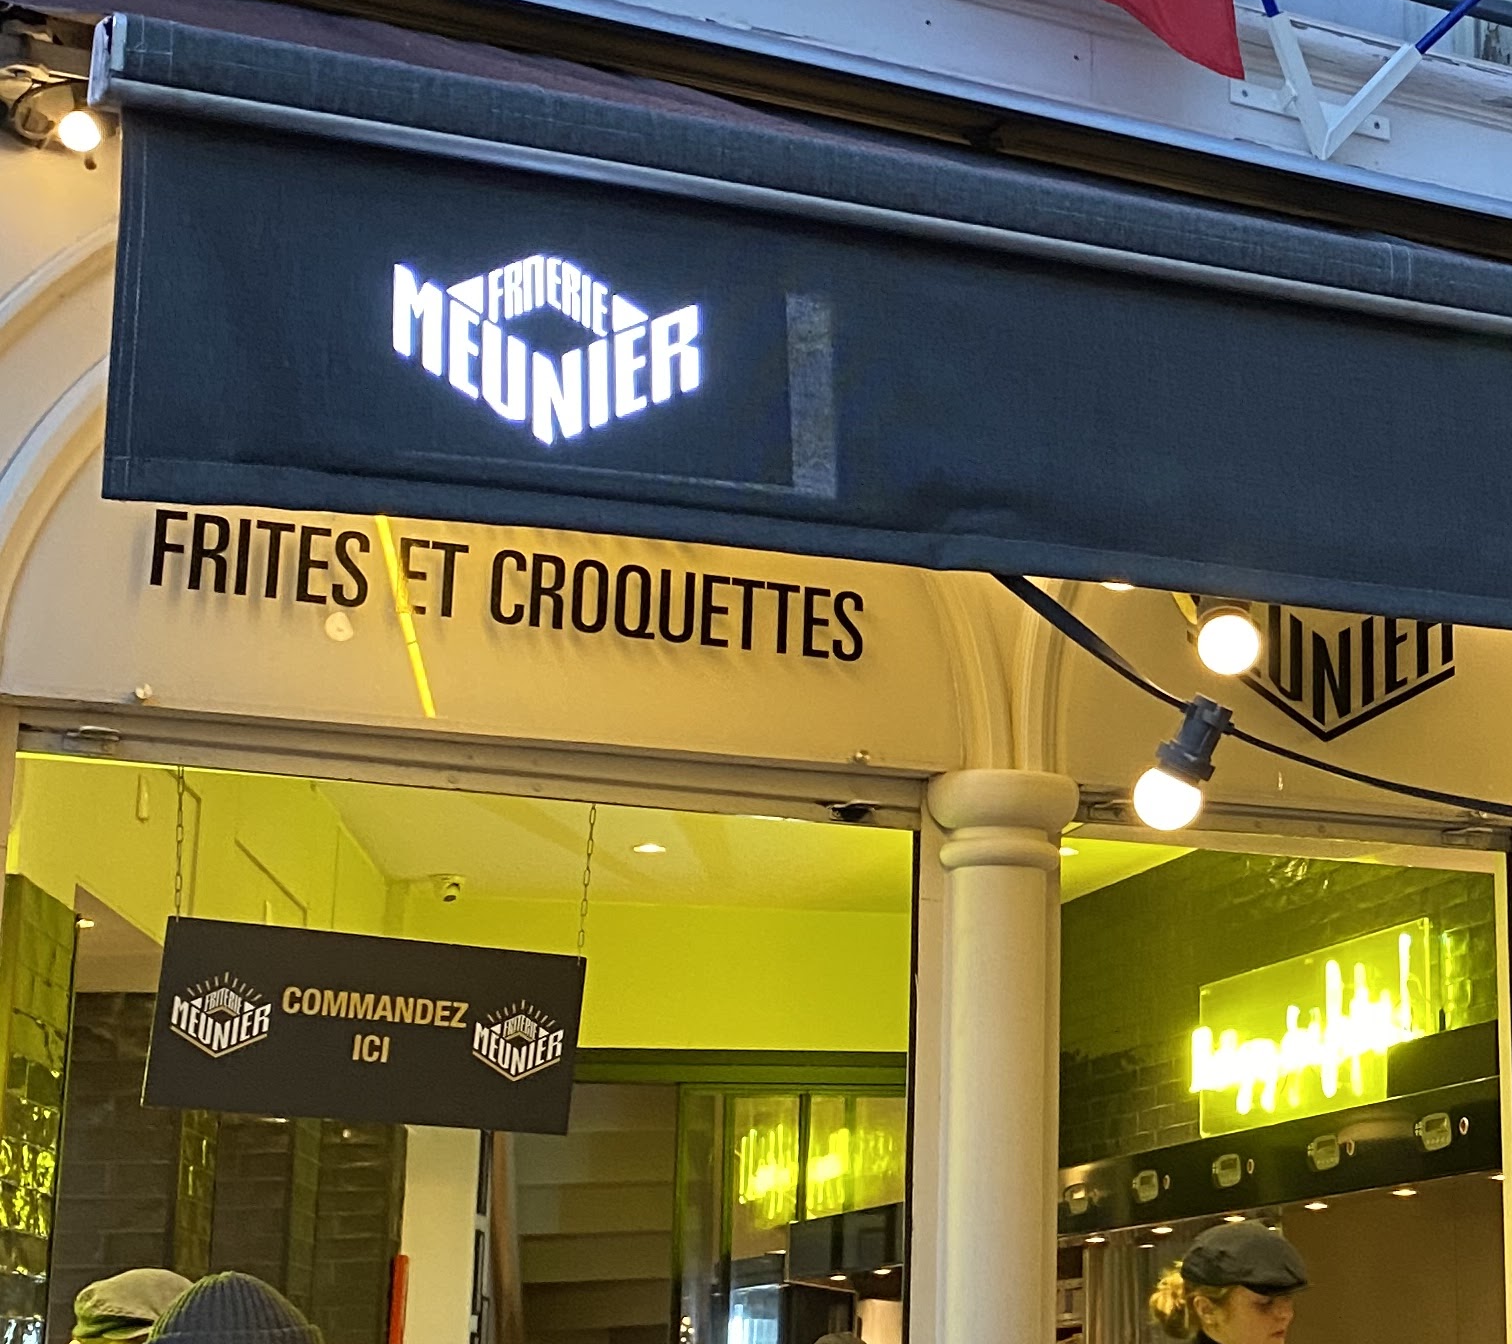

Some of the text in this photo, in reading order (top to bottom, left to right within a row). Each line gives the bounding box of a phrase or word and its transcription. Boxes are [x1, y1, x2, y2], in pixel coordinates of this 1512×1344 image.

[488, 254, 608, 337] FRITERIE
[392, 262, 699, 445] MEUNIER
[149, 508, 864, 662] FRITES ET CROQUETTES
[171, 995, 272, 1052] MEUNIER
[282, 986, 470, 1029] COMMANDEZ
[352, 1034, 391, 1064] ICI
[473, 1021, 564, 1076] MEUNIER
